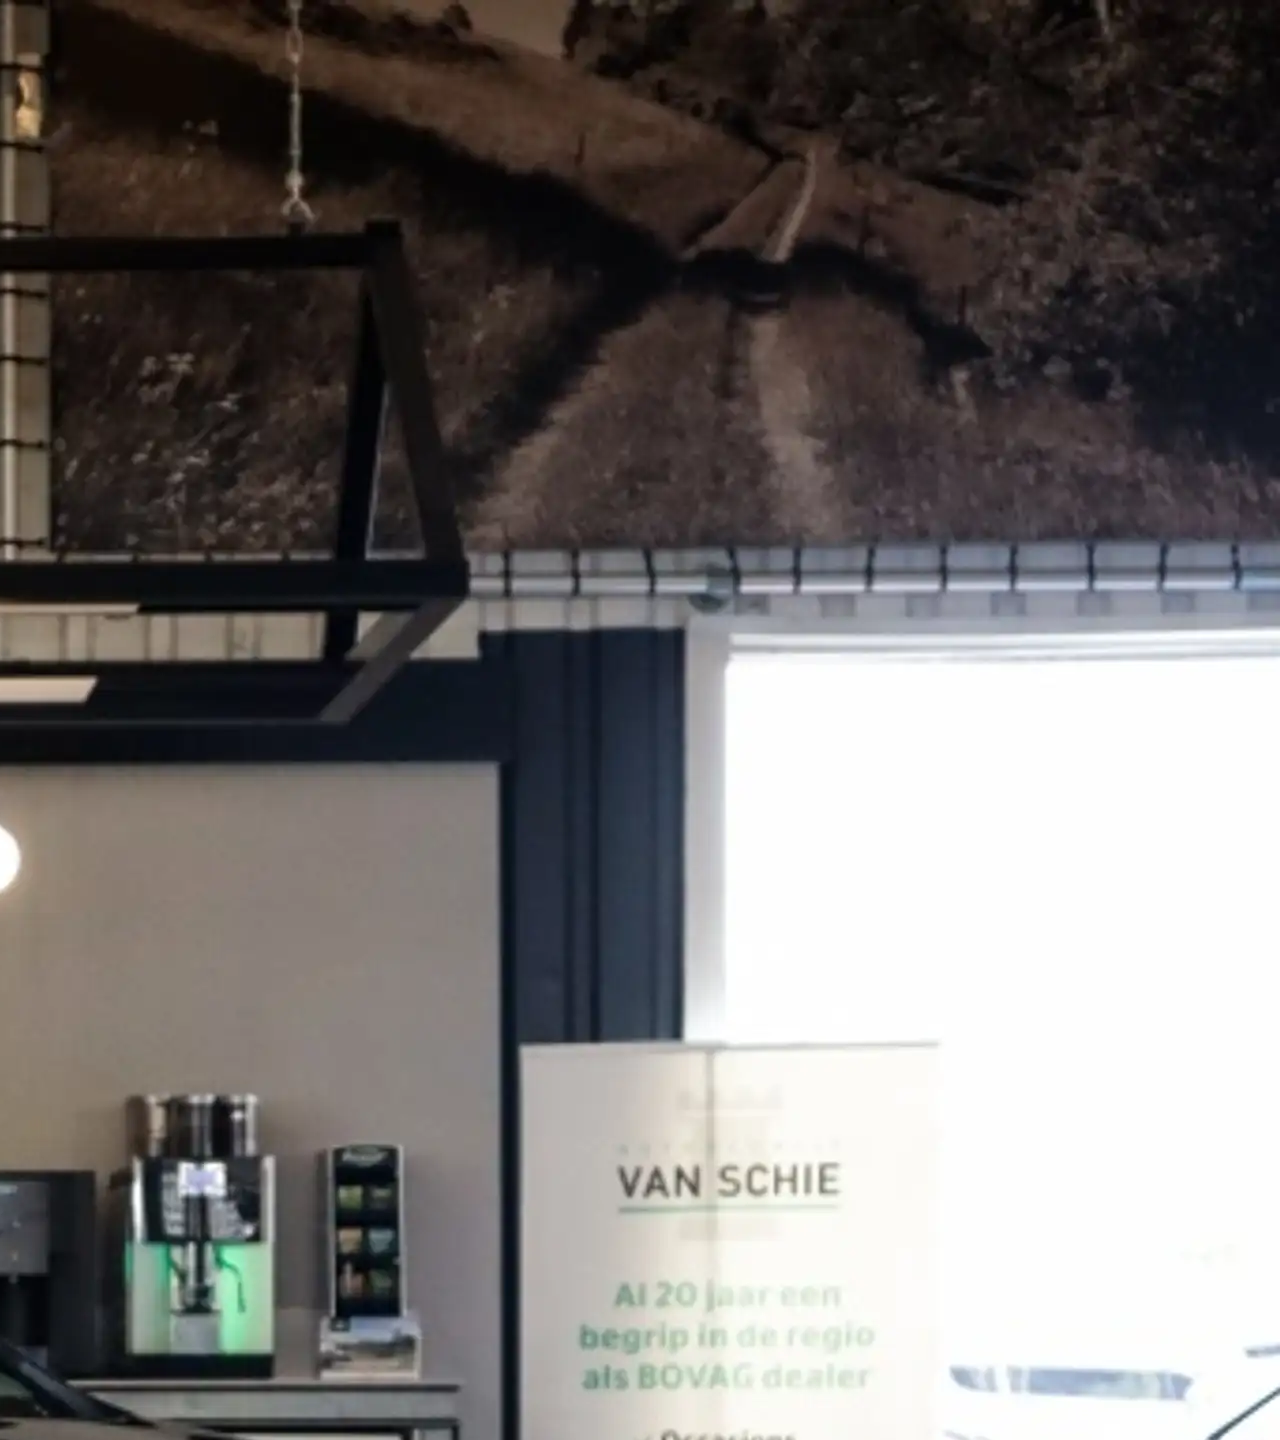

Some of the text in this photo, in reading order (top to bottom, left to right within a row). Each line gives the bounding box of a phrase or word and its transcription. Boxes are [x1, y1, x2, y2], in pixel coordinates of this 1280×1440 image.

[617, 1161, 842, 1199] VAN SCHIE
[614, 1279, 842, 1312] Al 20 jaar een
[579, 1321, 876, 1355] begrip in de regio
[581, 1361, 870, 1390] als BOVAG dealer
